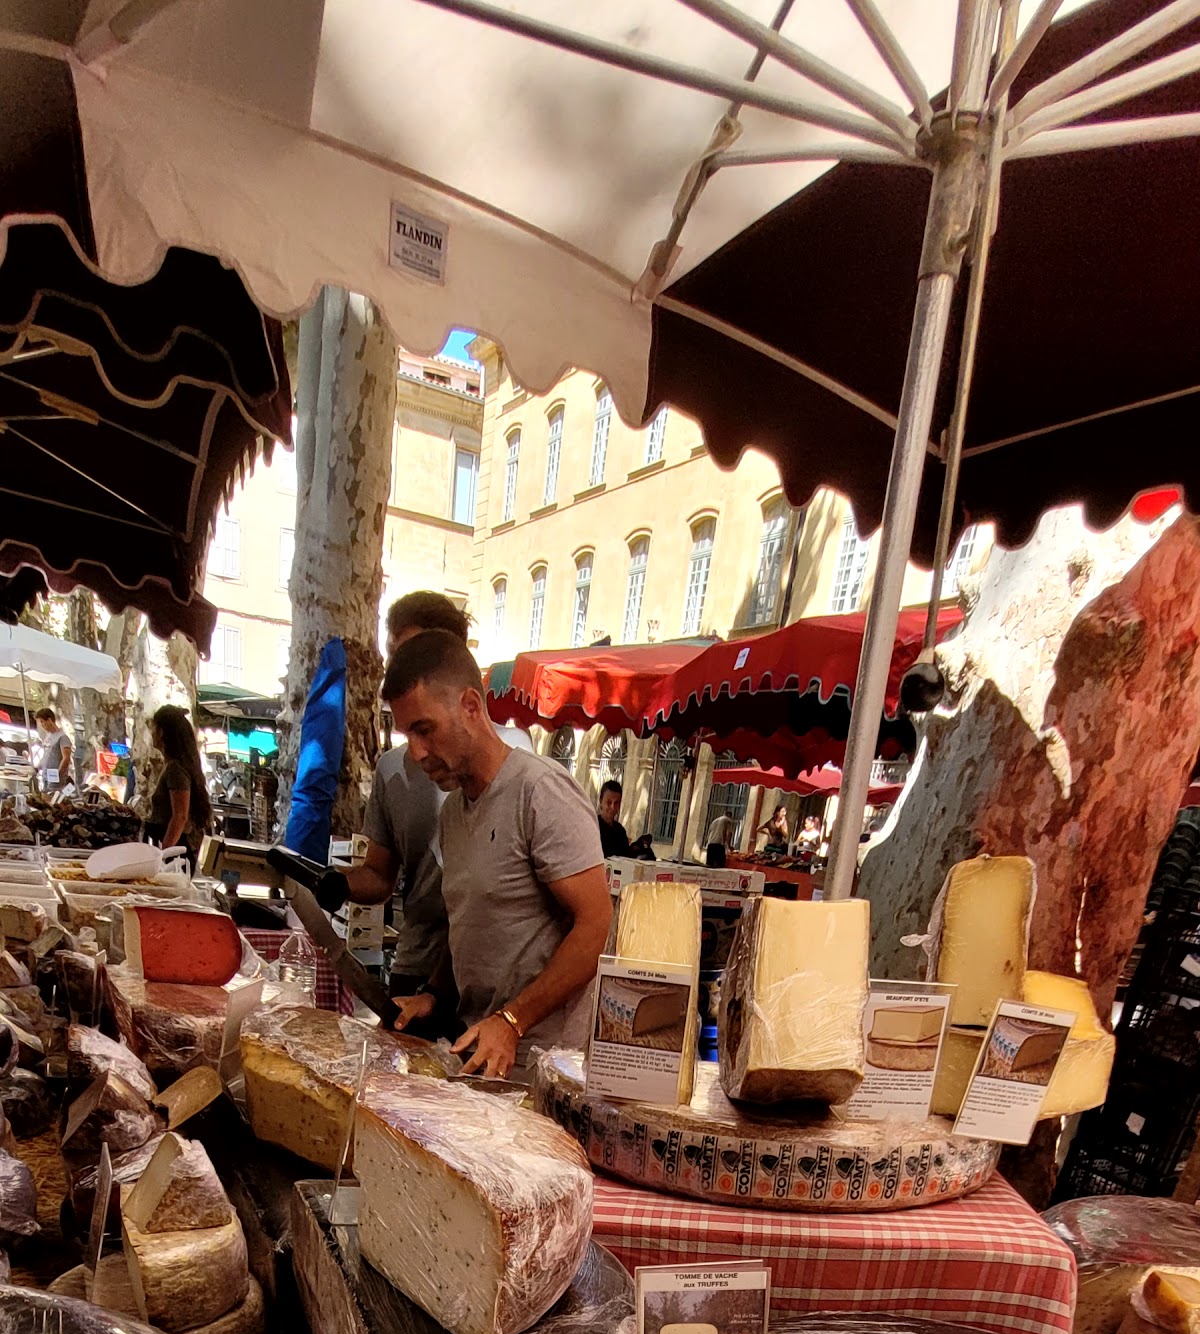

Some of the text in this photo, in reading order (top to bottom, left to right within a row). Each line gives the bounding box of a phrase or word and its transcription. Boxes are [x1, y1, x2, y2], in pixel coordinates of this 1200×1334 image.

[396, 220, 442, 251] FLANDIN
[700, 1135, 716, 1191] COMTE
[738, 1140, 754, 1196] COMTE
[776, 1143, 793, 1198] COMTE
[813, 1145, 830, 1200] COMTE
[850, 1156, 866, 1200] COMT
[914, 1144, 931, 1197] COMTE
